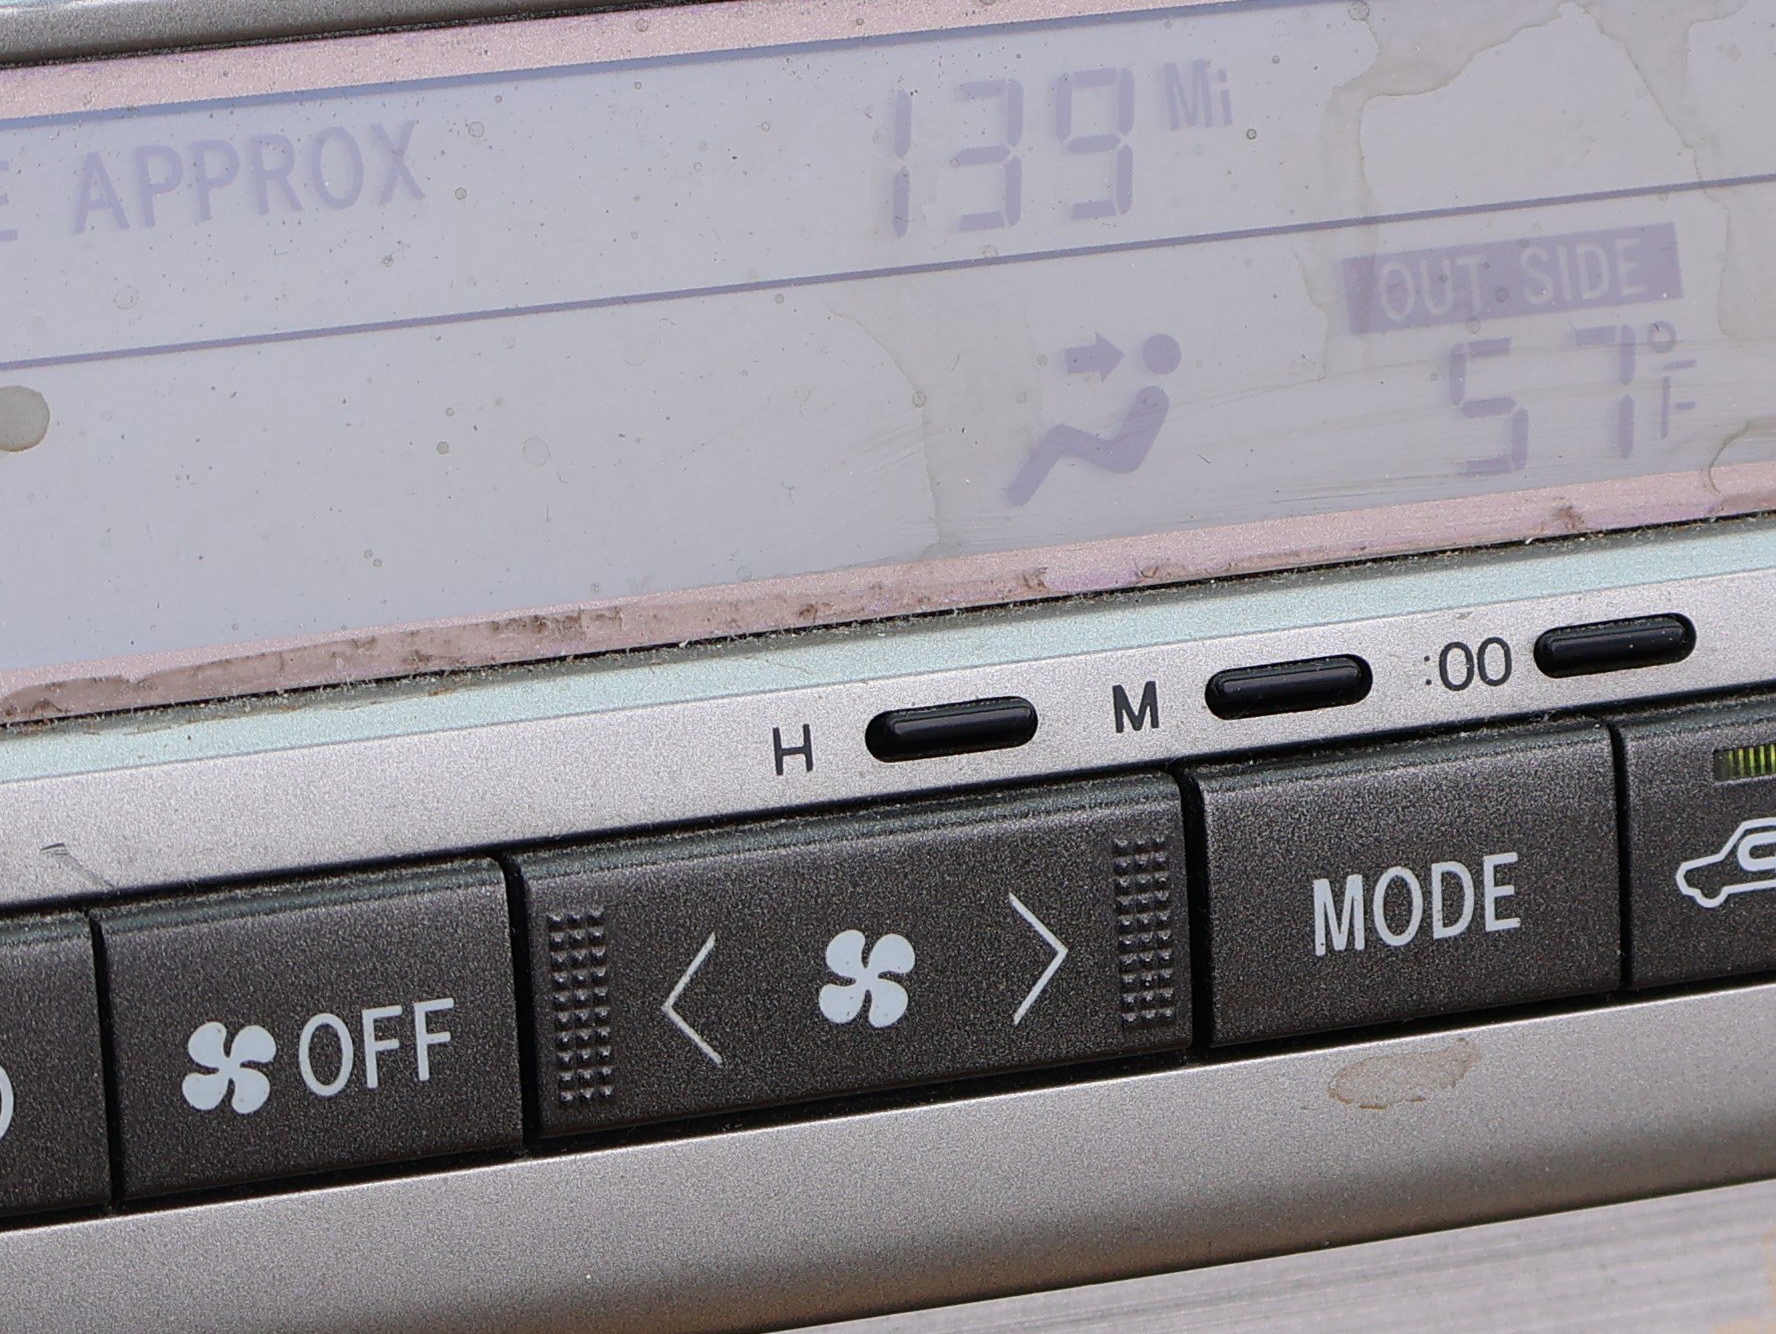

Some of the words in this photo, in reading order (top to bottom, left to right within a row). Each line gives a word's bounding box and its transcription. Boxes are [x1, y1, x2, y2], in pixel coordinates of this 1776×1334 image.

[72, 119, 428, 237] APPROX
[877, 67, 1136, 241] 139
[1162, 59, 1234, 133] Mi
[1377, 246, 1496, 323] OUT
[1521, 231, 1648, 307] SIDE
[771, 722, 815, 777] H
[1112, 680, 1160, 735] M
[1312, 850, 1525, 958] MODE
[296, 996, 458, 1098] OFF
